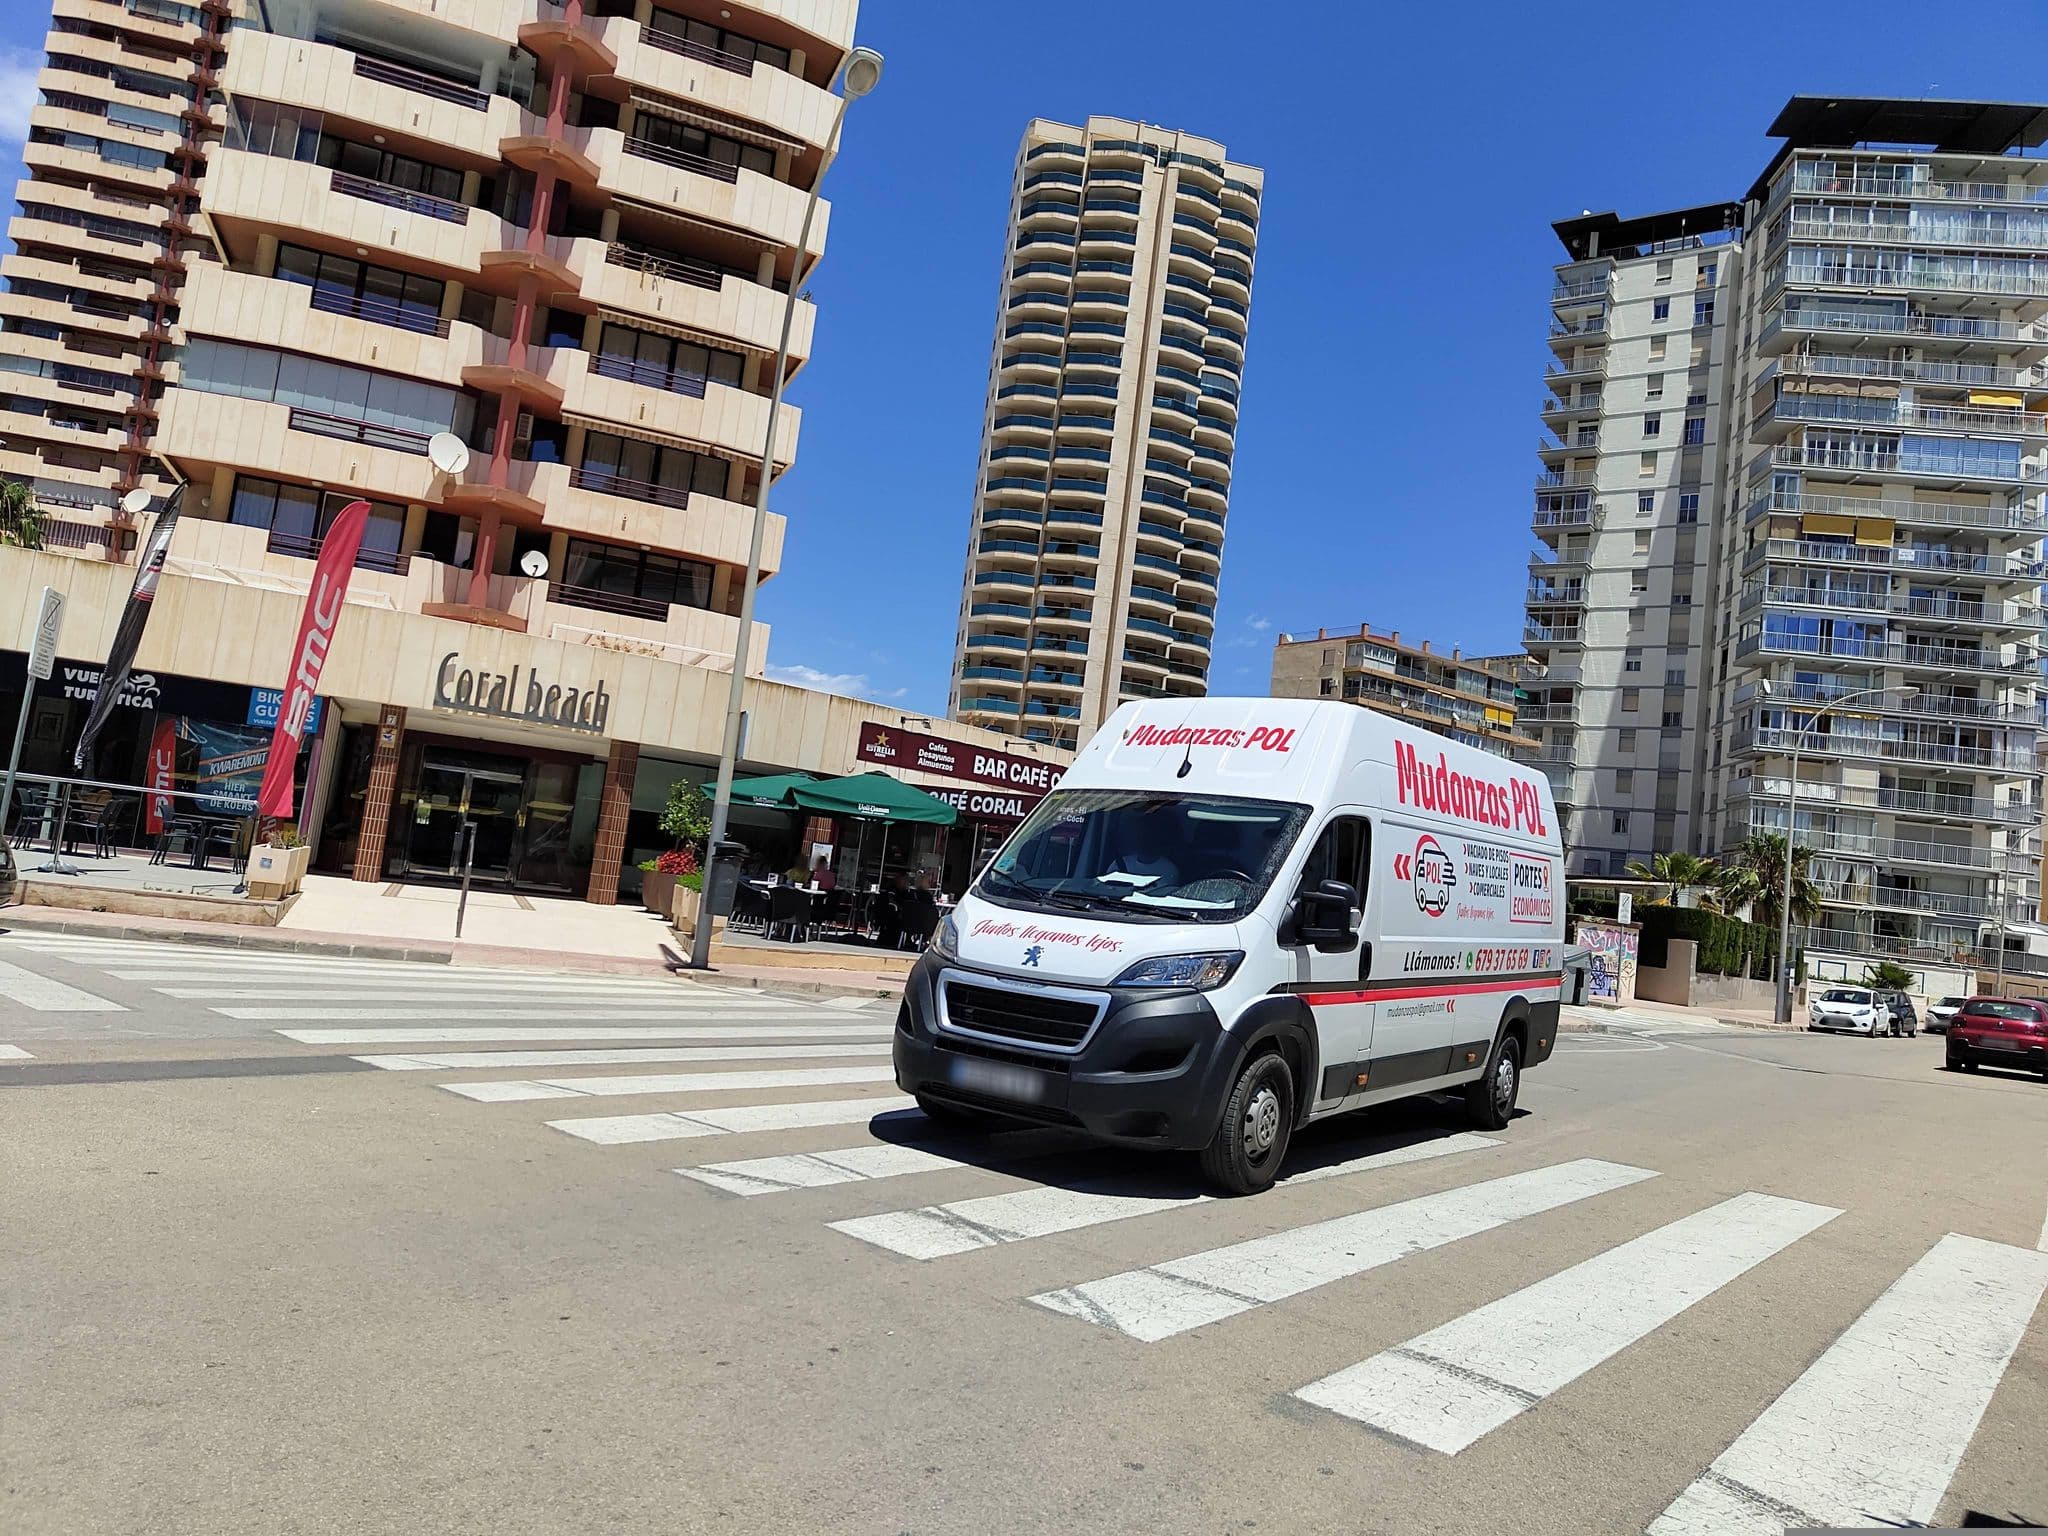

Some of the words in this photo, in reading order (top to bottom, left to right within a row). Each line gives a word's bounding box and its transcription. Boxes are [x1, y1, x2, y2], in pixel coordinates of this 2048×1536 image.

[64, 685, 153, 709] TURTICA
[433, 652, 520, 712] Coral
[524, 667, 610, 733] beach
[928, 742, 948, 754] Cafés
[1126, 723, 1246, 748] Mudanzas
[1243, 726, 1296, 752] POL
[209, 752, 268, 775] KWAREMONT
[917, 757, 954, 772] Almuerzos
[918, 748, 955, 764] Desayunos
[974, 755, 1007, 780] BAR
[1010, 763, 1049, 788] CAFÉ
[1394, 740, 1511, 829] Mudanzas
[1510, 777, 1547, 837] POL
[970, 794, 1026, 818] CORAL
[1467, 843, 1488, 860] VACIADO
[1488, 847, 1495, 860] DE
[1495, 849, 1509, 863] PISOS
[1426, 861, 1441, 883] POL
[1469, 862, 1485, 878] NAVES
[1489, 866, 1508, 880] LOCALES
[1514, 863, 1542, 889] PORTES
[1473, 882, 1505, 898] COMERCIALES
[1513, 892, 1551, 916] ECONÓMICOS
[970, 919, 1020, 937] Juntos
[1019, 925, 1086, 944] llegamos
[1404, 950, 1455, 972] Llámanos
[1475, 948, 1493, 971] 679
[1493, 949, 1506, 971] 37
[1506, 949, 1517, 970] 65
[1517, 948, 1529, 969] 69
